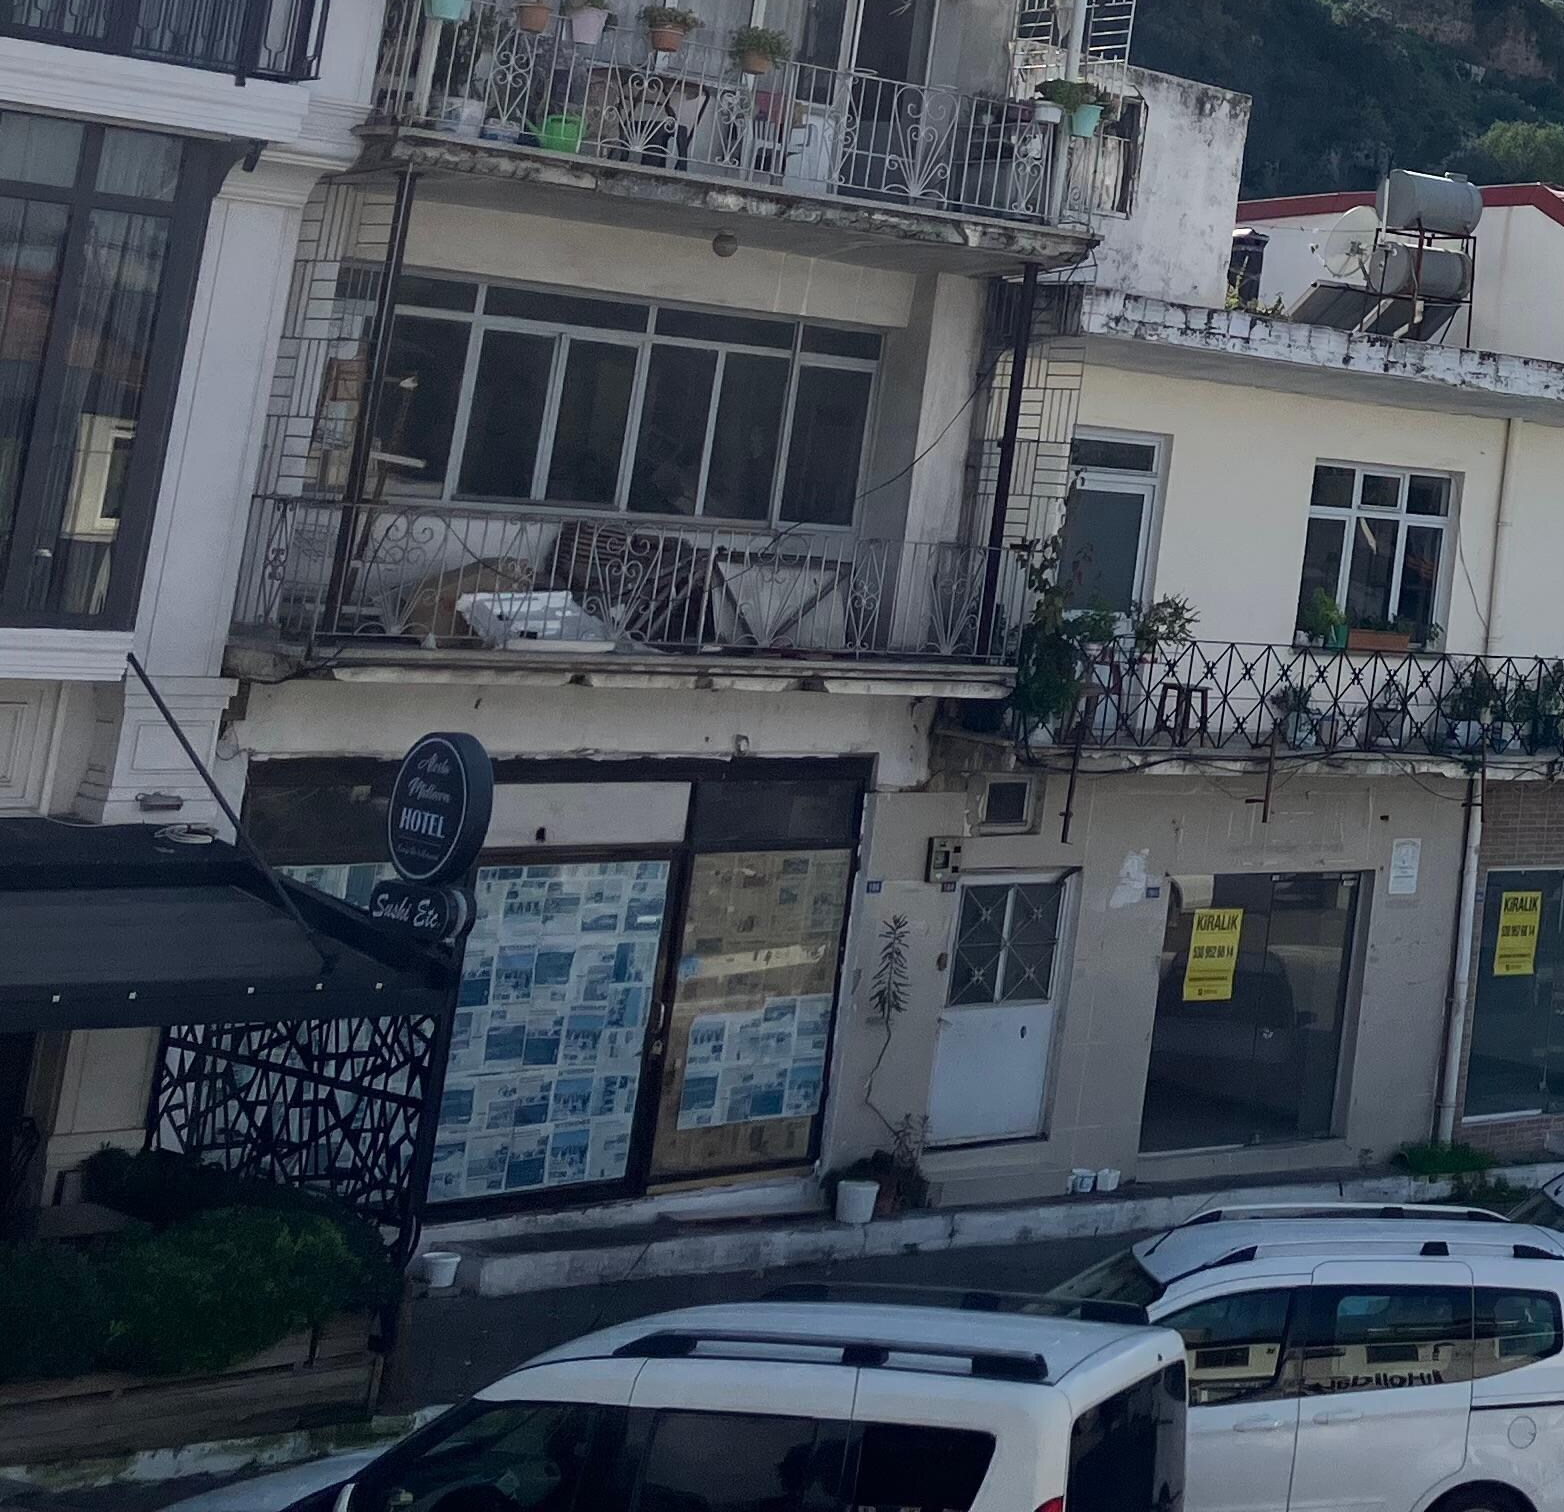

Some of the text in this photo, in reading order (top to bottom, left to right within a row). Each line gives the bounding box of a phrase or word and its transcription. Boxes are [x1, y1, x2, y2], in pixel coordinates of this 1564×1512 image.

[399, 807, 446, 839] HOTEL
[372, 893, 413, 922] Sushi
[1503, 895, 1540, 913] KİRALIK
[1196, 913, 1239, 932] KİRALIK
